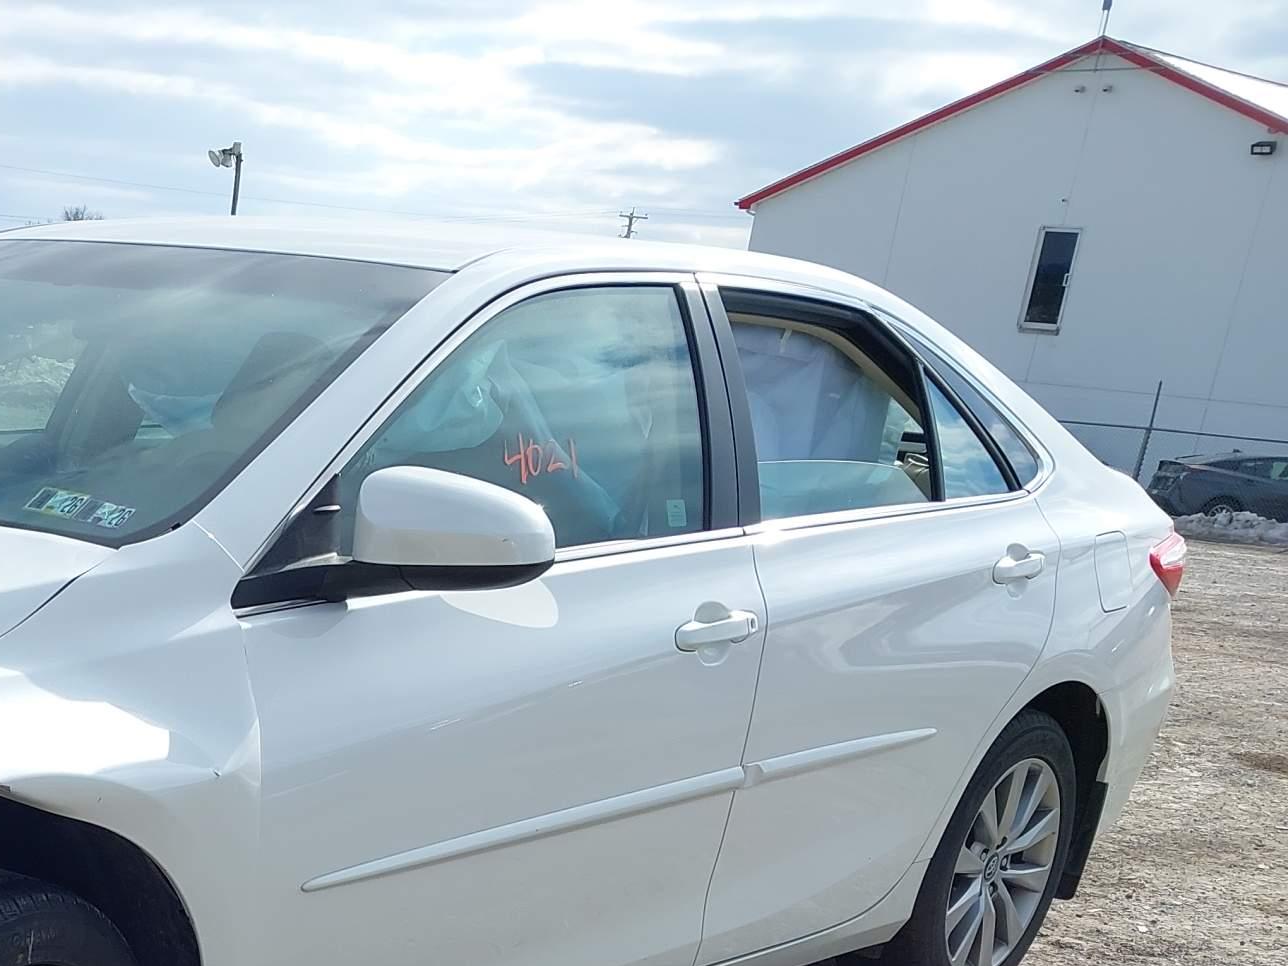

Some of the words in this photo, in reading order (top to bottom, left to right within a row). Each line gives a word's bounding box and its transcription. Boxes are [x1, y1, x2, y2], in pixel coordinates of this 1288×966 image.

[504, 431, 579, 485] 4021
[60, 495, 85, 514] 26
[108, 508, 133, 527] 26
